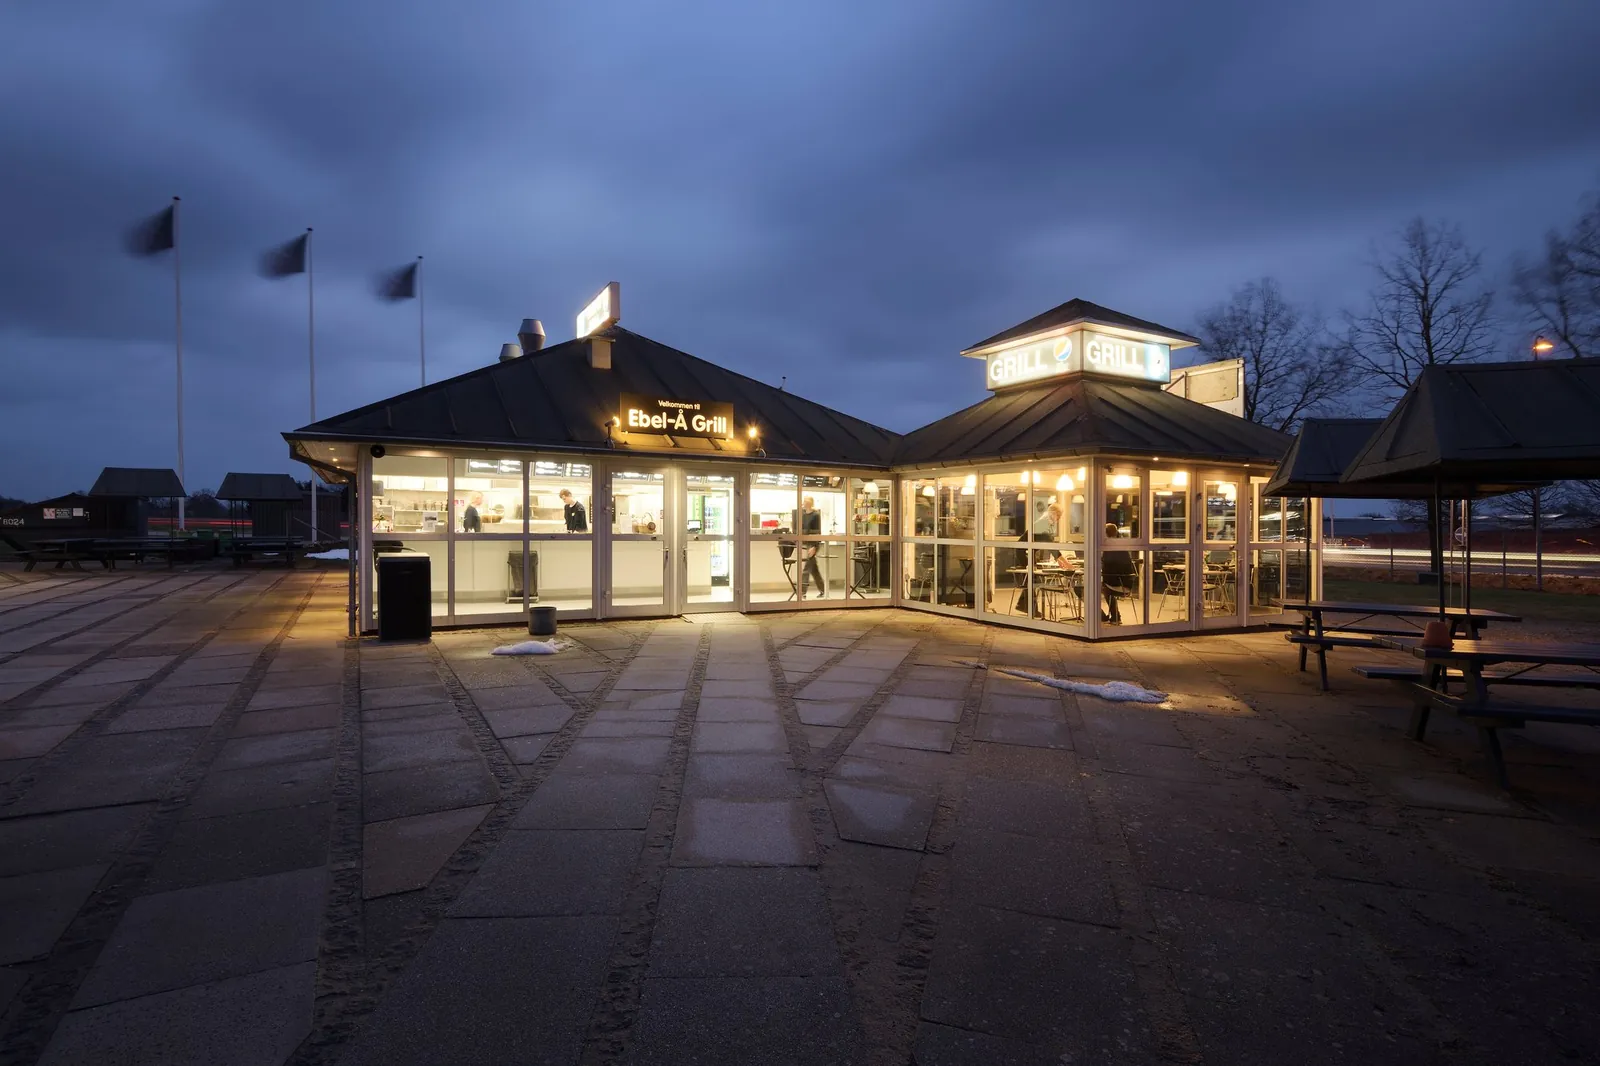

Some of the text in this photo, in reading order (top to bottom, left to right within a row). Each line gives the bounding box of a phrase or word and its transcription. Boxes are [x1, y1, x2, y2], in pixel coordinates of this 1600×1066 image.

[990, 350, 1048, 381] GRILL
[1086, 340, 1143, 369] GRILL
[658, 399, 693, 409] Velkommen
[628, 409, 727, 434] Ebel-Å Grill
